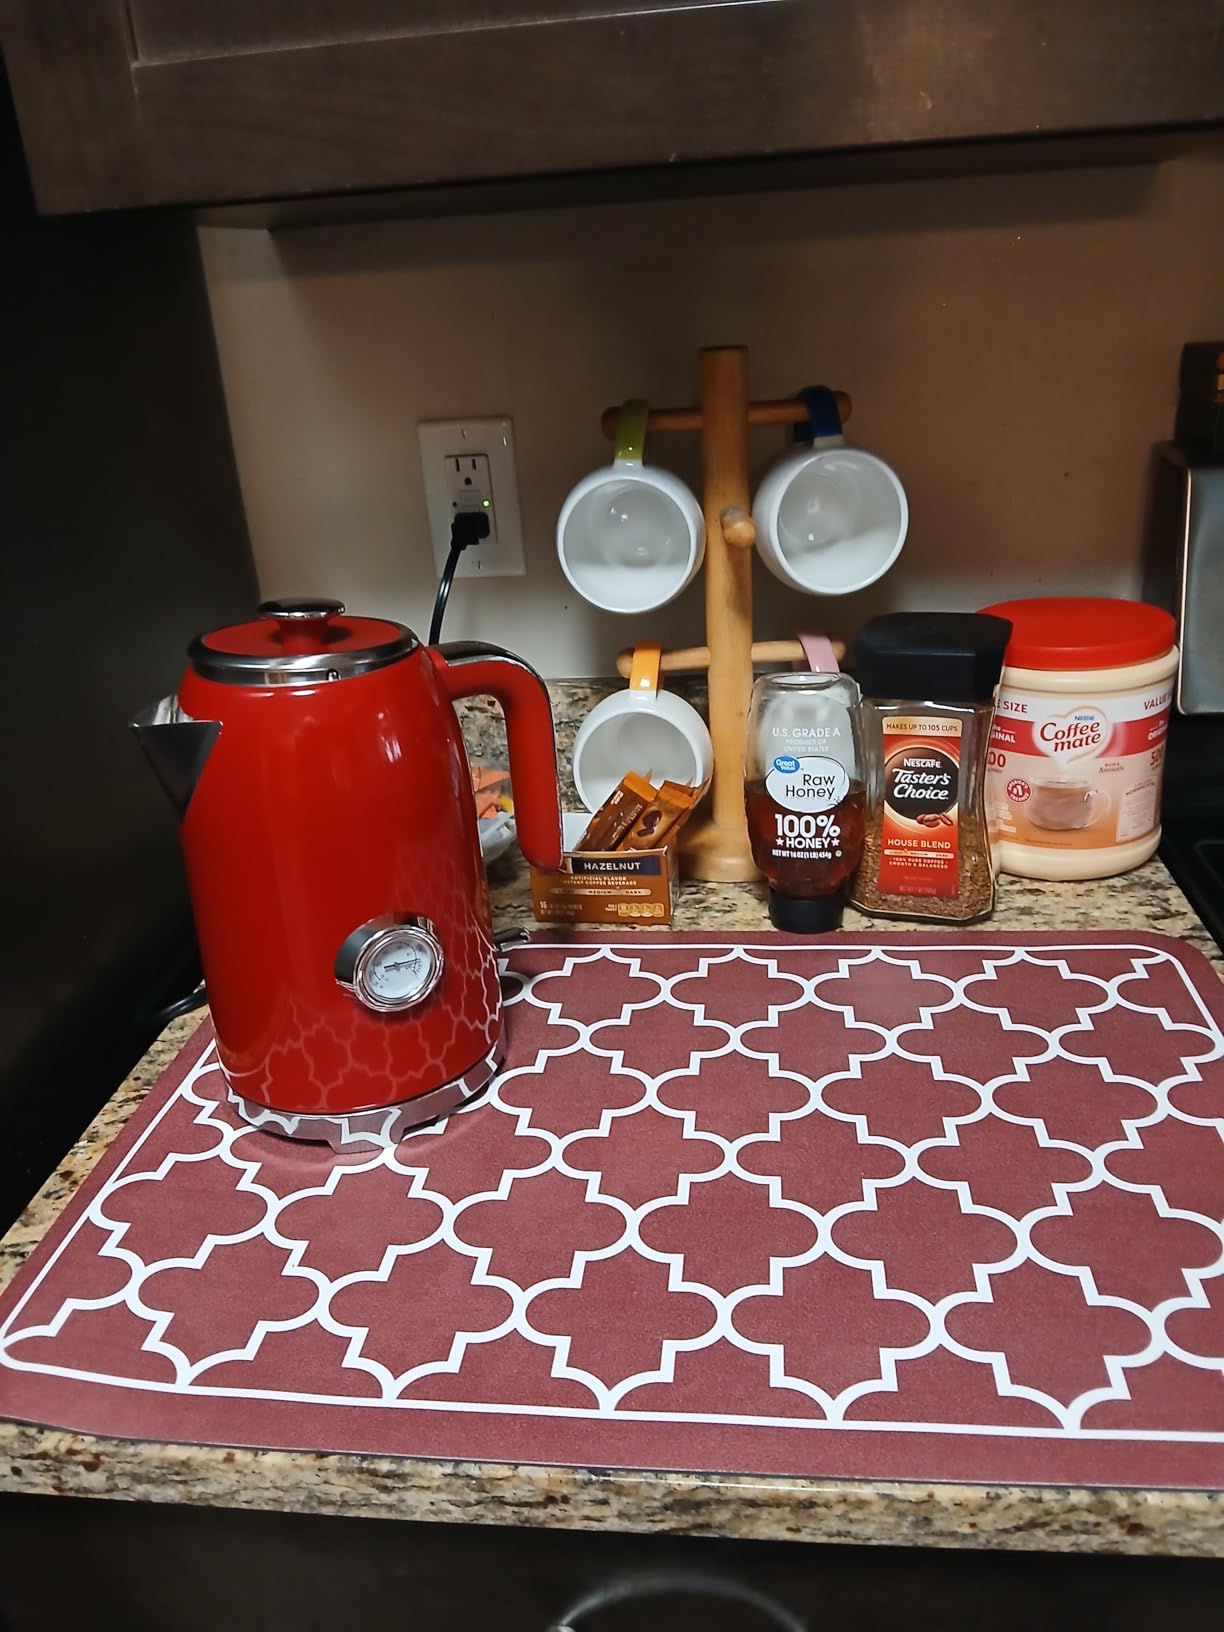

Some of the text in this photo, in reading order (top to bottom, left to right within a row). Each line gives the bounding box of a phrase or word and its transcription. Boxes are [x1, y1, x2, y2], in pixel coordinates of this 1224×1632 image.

[1003, 700, 1029, 713] SIZE
[792, 728, 830, 738] GRADE
[832, 727, 841, 737] A
[1040, 722, 1101, 742] Coffee
[1053, 733, 1101, 752] mate
[775, 758, 796, 768] Great
[803, 773, 836, 787] Raw
[892, 768, 952, 786] Taster's
[785, 785, 835, 801] Honey
[893, 783, 949, 800] Choice
[774, 813, 841, 838] 100%
[785, 836, 831, 849] HONEY
[887, 838, 951, 849] HOUSE BLEND
[584, 862, 641, 870] HAZELNUT
